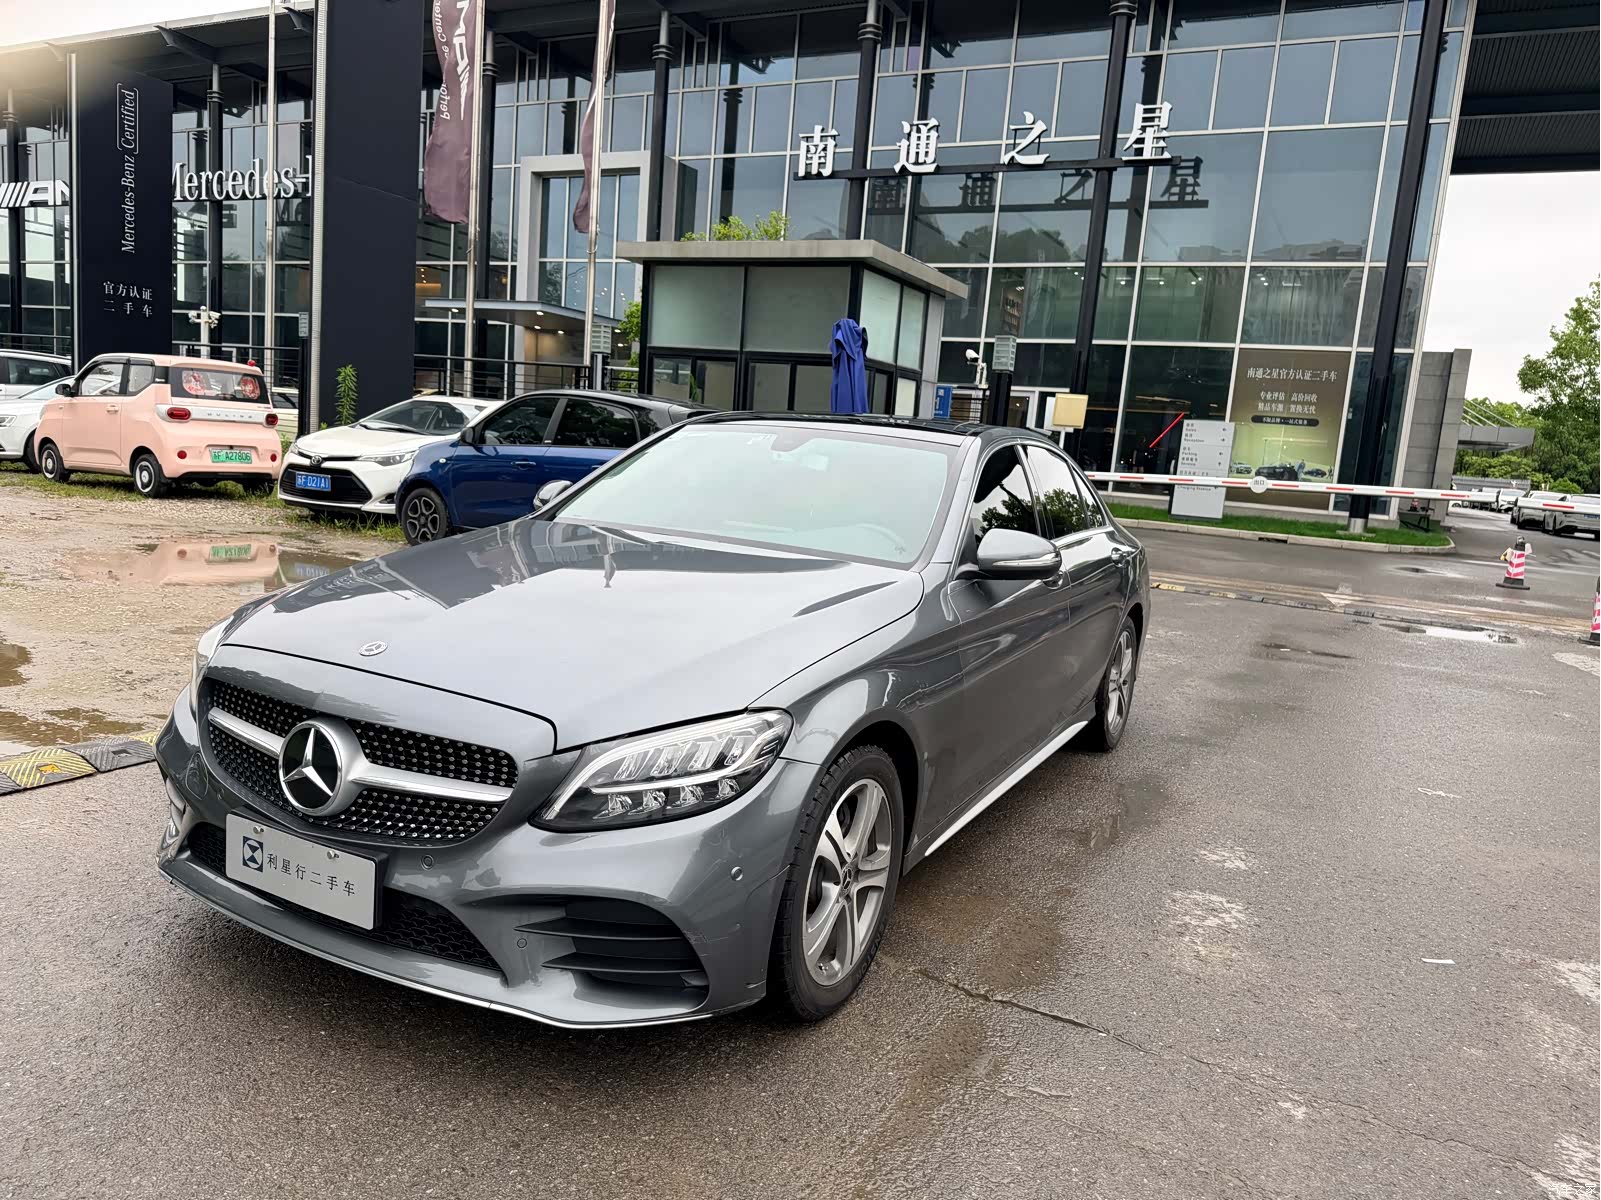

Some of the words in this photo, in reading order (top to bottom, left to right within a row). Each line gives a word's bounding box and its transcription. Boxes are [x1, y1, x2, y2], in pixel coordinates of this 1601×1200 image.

[121, 89, 135, 149] Certified
[798, 101, 1173, 178] 南通之星
[172, 155, 313, 201] Mercedes-
[121, 154, 135, 254] Mercedes-Benz
[103, 281, 153, 301] 官方认证
[103, 300, 153, 318] 二手车
[1247, 367, 1338, 382] 南通之星官方认证二手车
[266, 853, 356, 897] 利星行二手车
